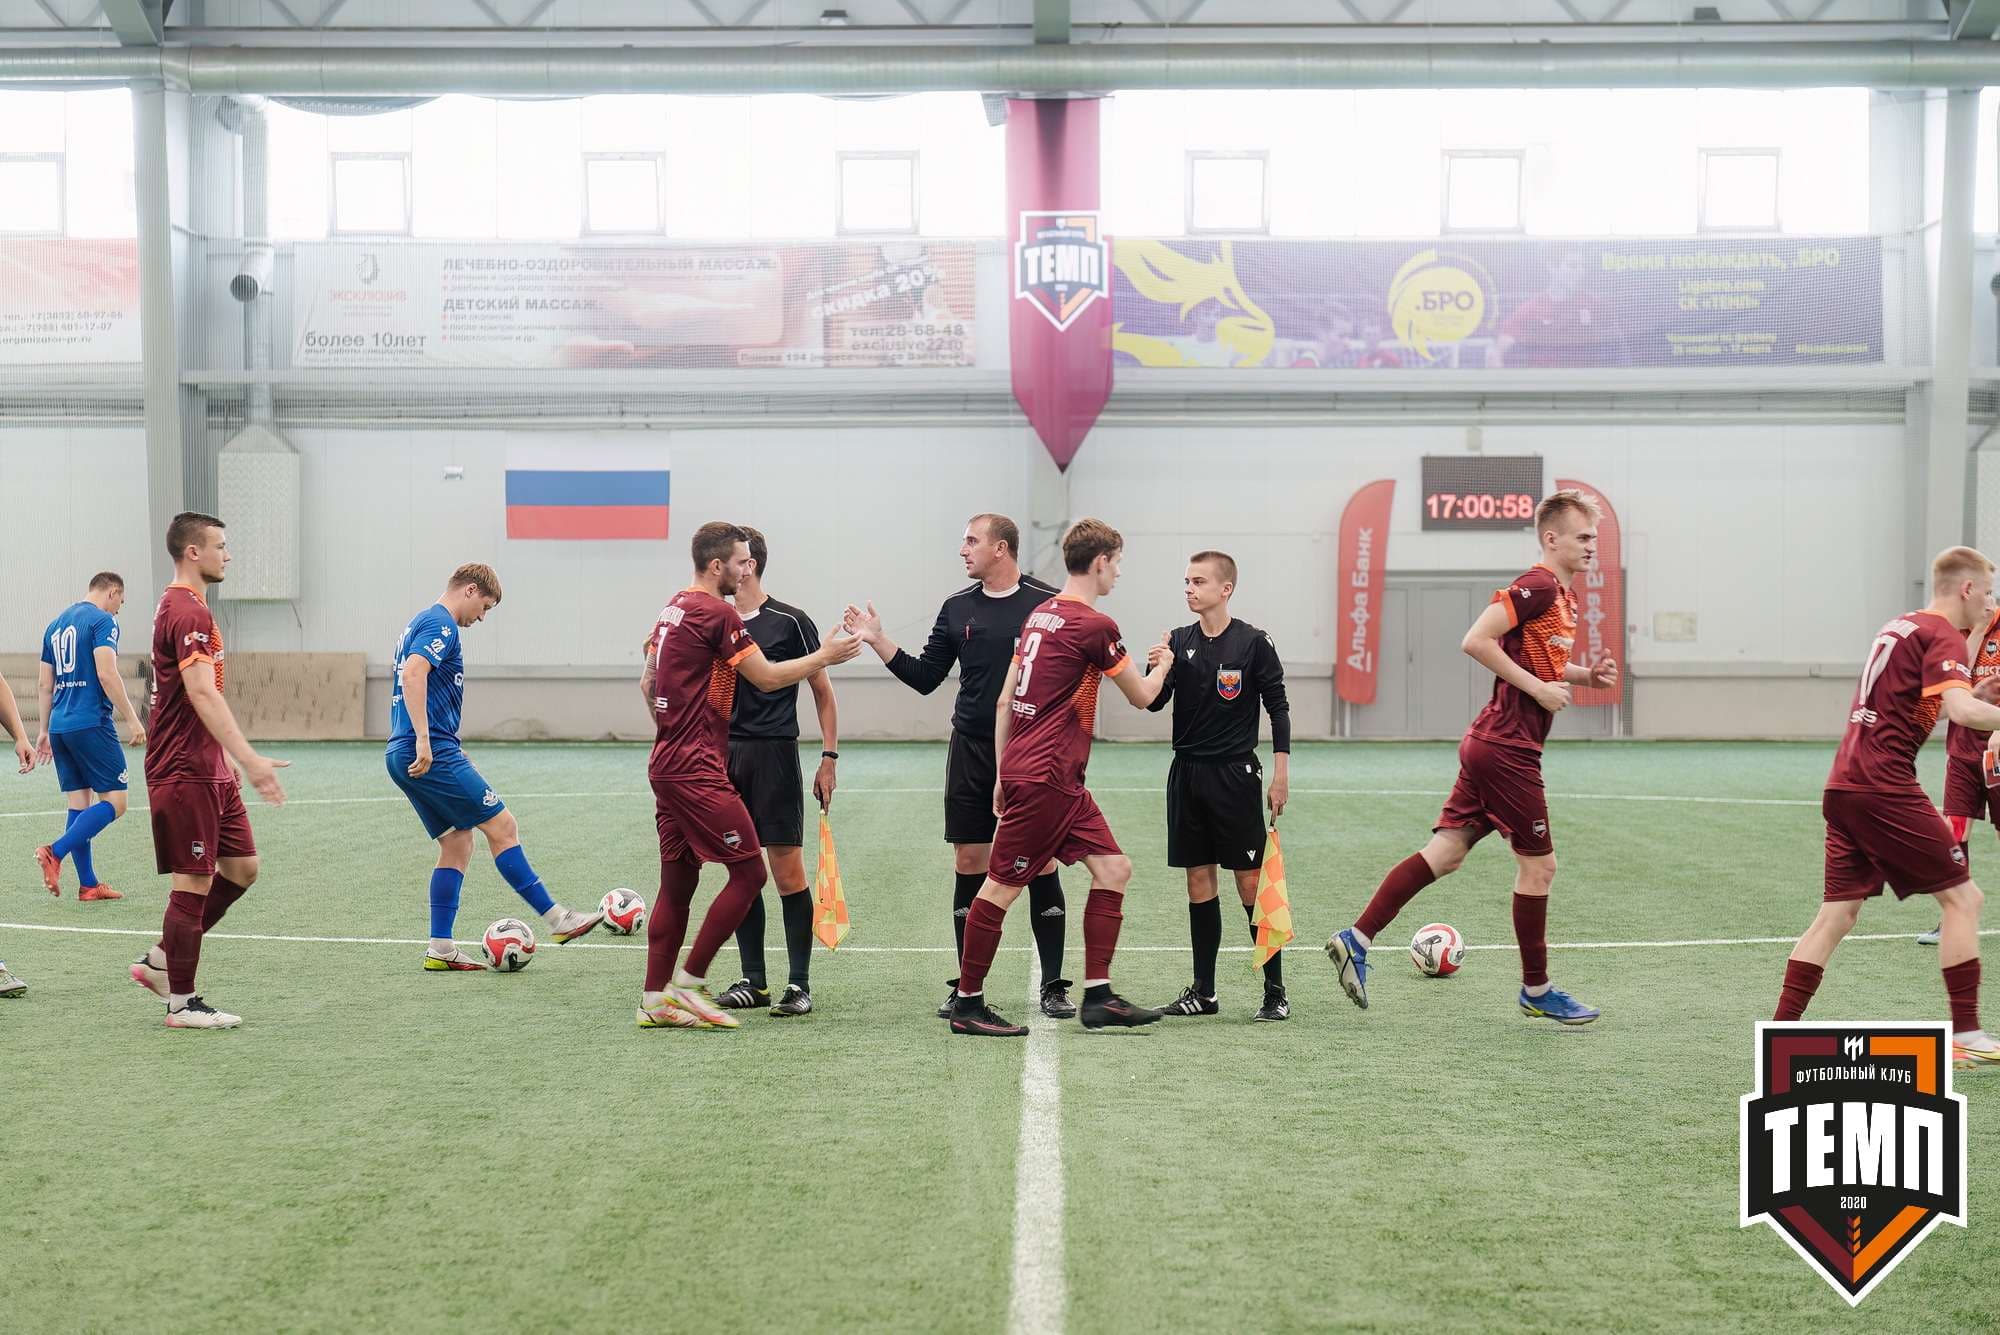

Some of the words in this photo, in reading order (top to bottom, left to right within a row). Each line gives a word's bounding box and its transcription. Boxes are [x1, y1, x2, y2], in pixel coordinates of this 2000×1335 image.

[443, 257, 694, 272] ЛЕЧЕБНО-ОЗДОРОВИТЕЛЬНЫЙ
[1024, 244, 1099, 285] ТЕМП
[1601, 253, 1665, 272] Время
[1671, 250, 1787, 272] побеждать,
[1793, 247, 1840, 268] .БРО
[443, 296, 520, 313] ДЕТСКИЙ
[1415, 291, 1474, 311] .БРО
[305, 331, 364, 347] более
[1426, 494, 1533, 518] 17:00:58
[1353, 527, 1373, 587] Банк
[1347, 591, 1371, 671] Альфа
[51, 624, 76, 676] 10
[1015, 632, 1042, 697] 3
